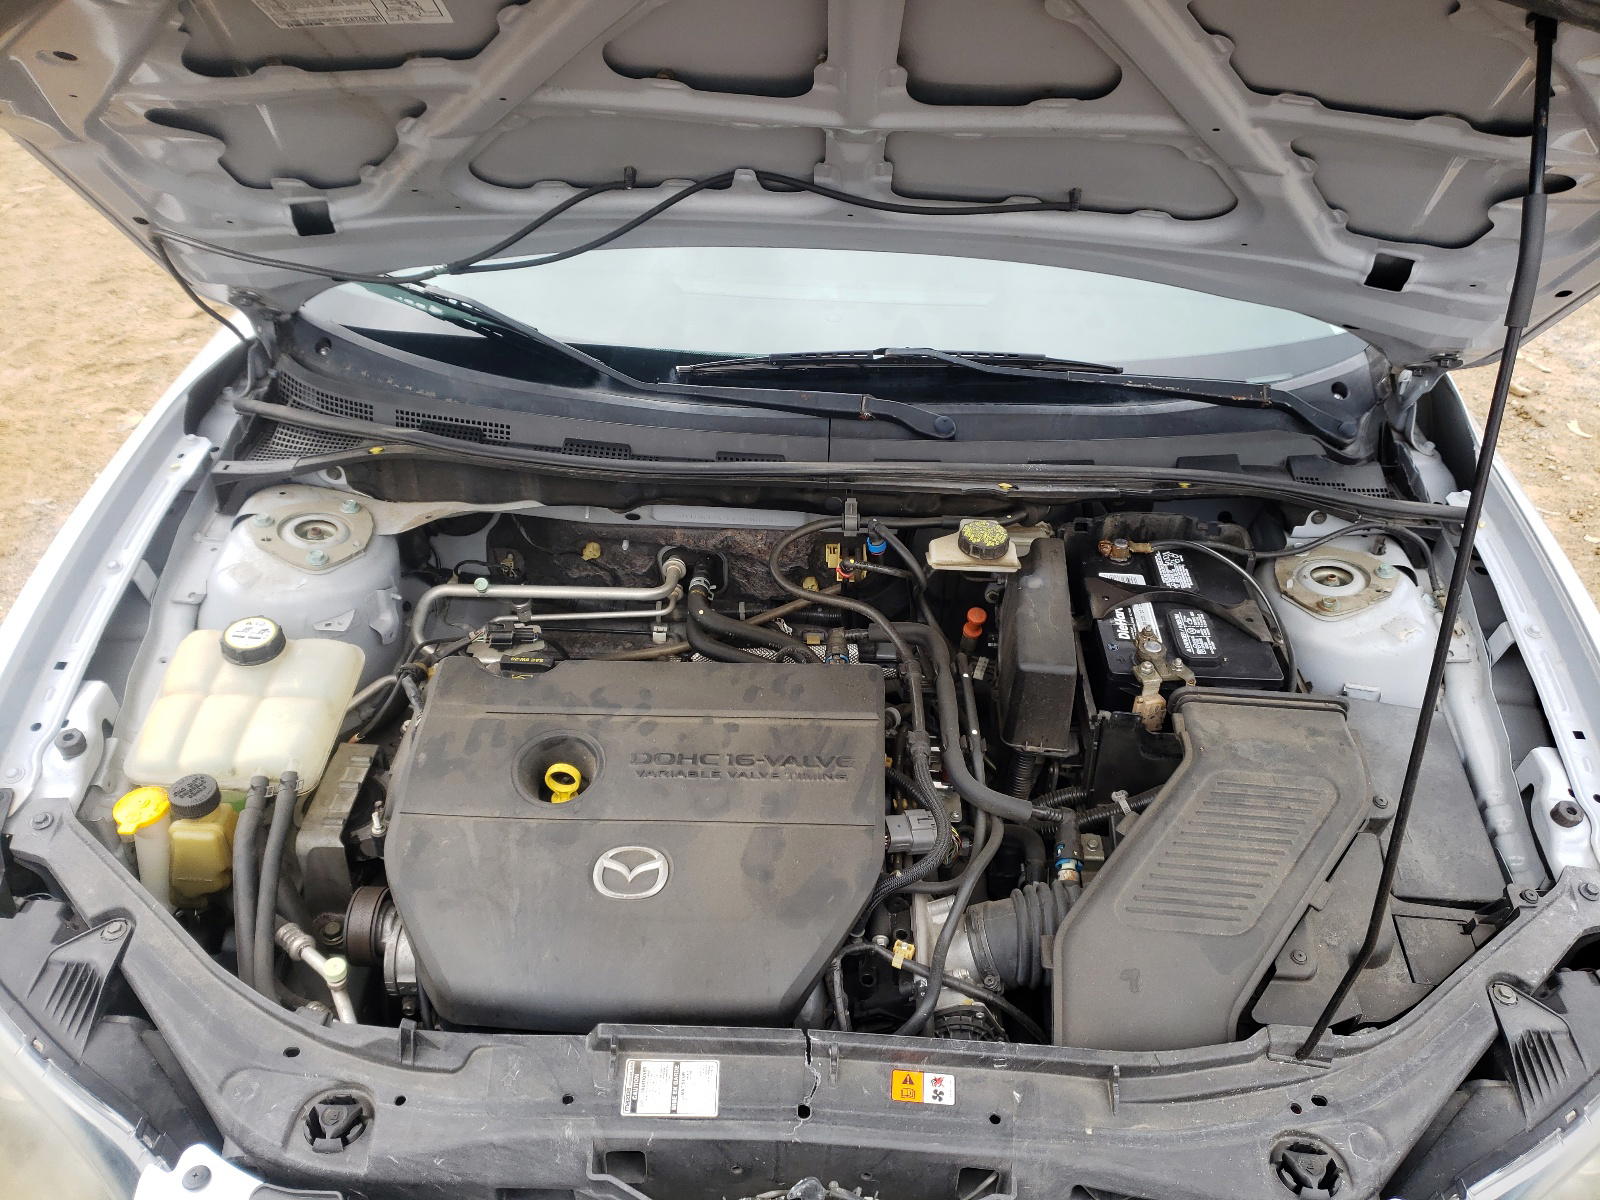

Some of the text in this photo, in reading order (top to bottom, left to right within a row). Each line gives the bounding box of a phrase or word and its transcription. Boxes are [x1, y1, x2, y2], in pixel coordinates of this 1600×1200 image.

[630, 752, 855, 768] DOHC 16-VALVE
[635, 769, 721, 779] VARIABLE
[727, 770, 780, 780] VALVE
[631, 1073, 640, 1101] CAUTION
